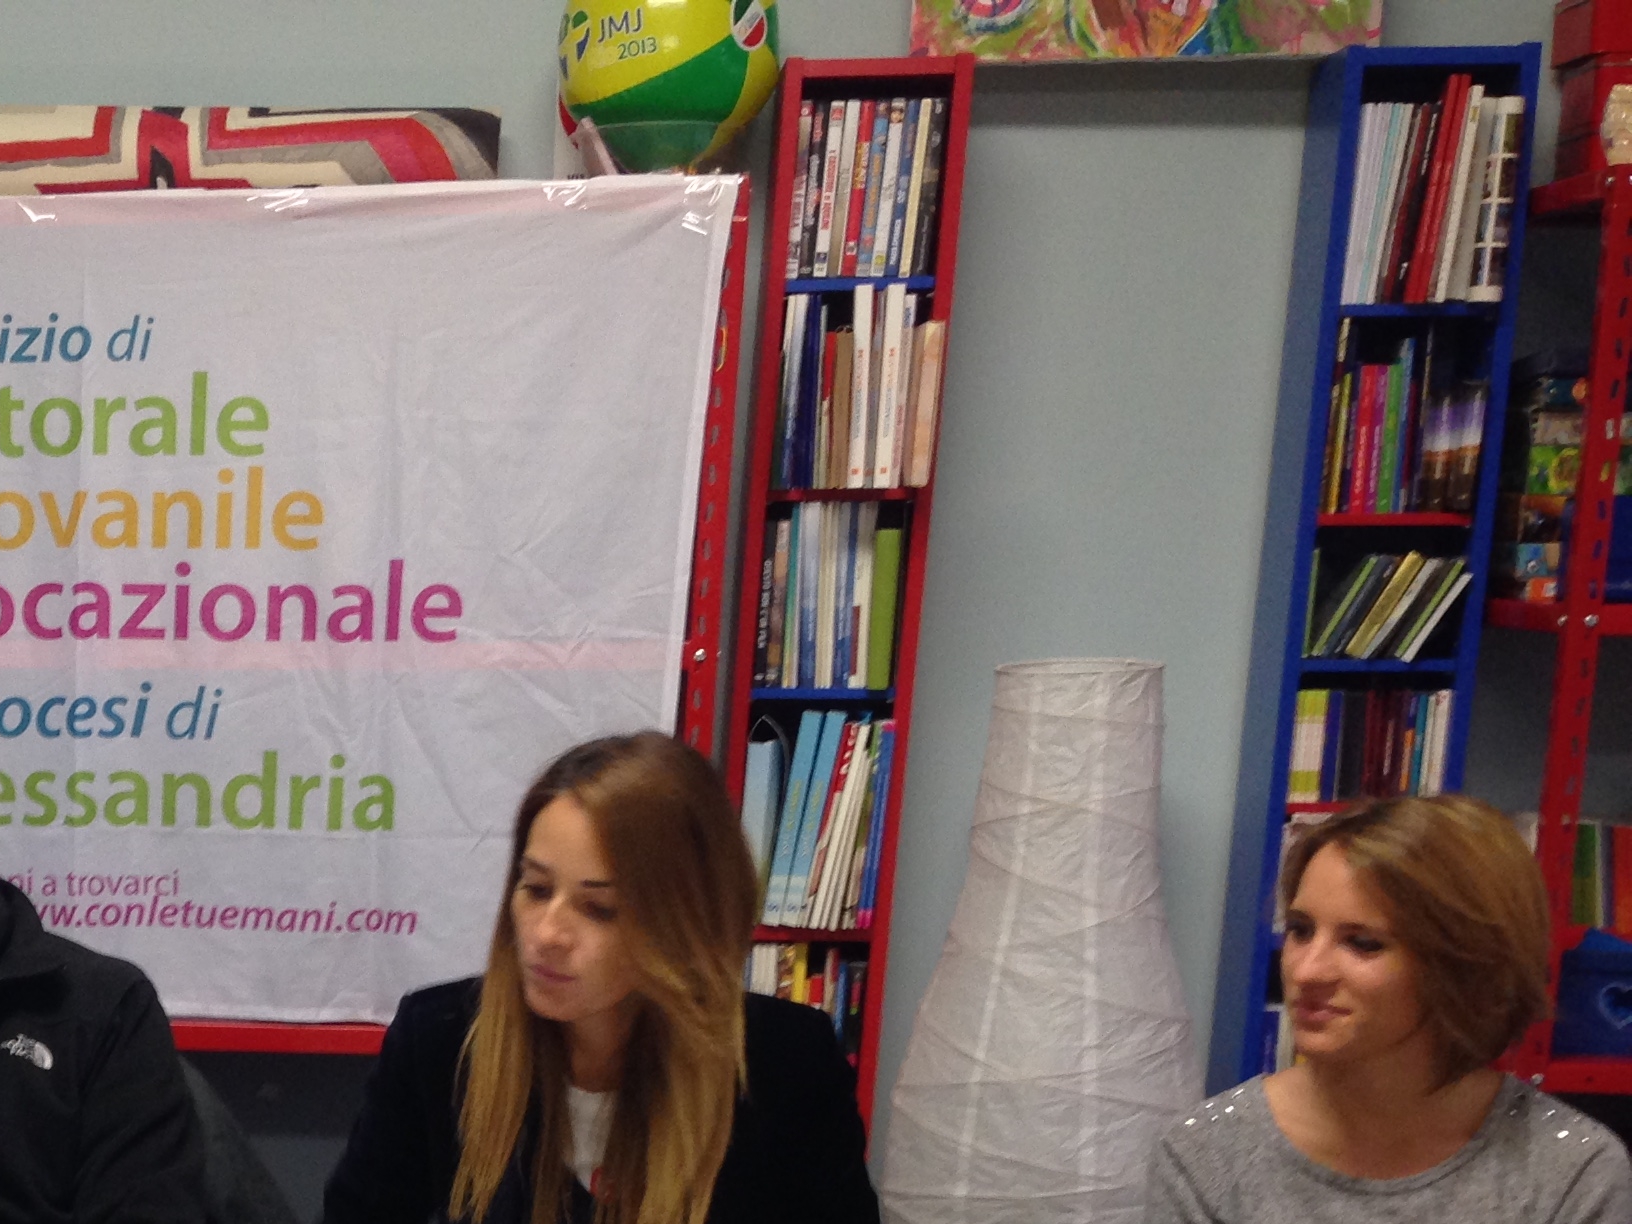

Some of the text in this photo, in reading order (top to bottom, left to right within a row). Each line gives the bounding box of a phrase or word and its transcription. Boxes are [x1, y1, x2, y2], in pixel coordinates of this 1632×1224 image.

[597, 7, 643, 44] JMJ
[617, 37, 658, 60] 2013
[107, 314, 156, 363] di
[167, 685, 223, 742] di
[42, 877, 57, 897] a
[68, 868, 181, 897] trovarci
